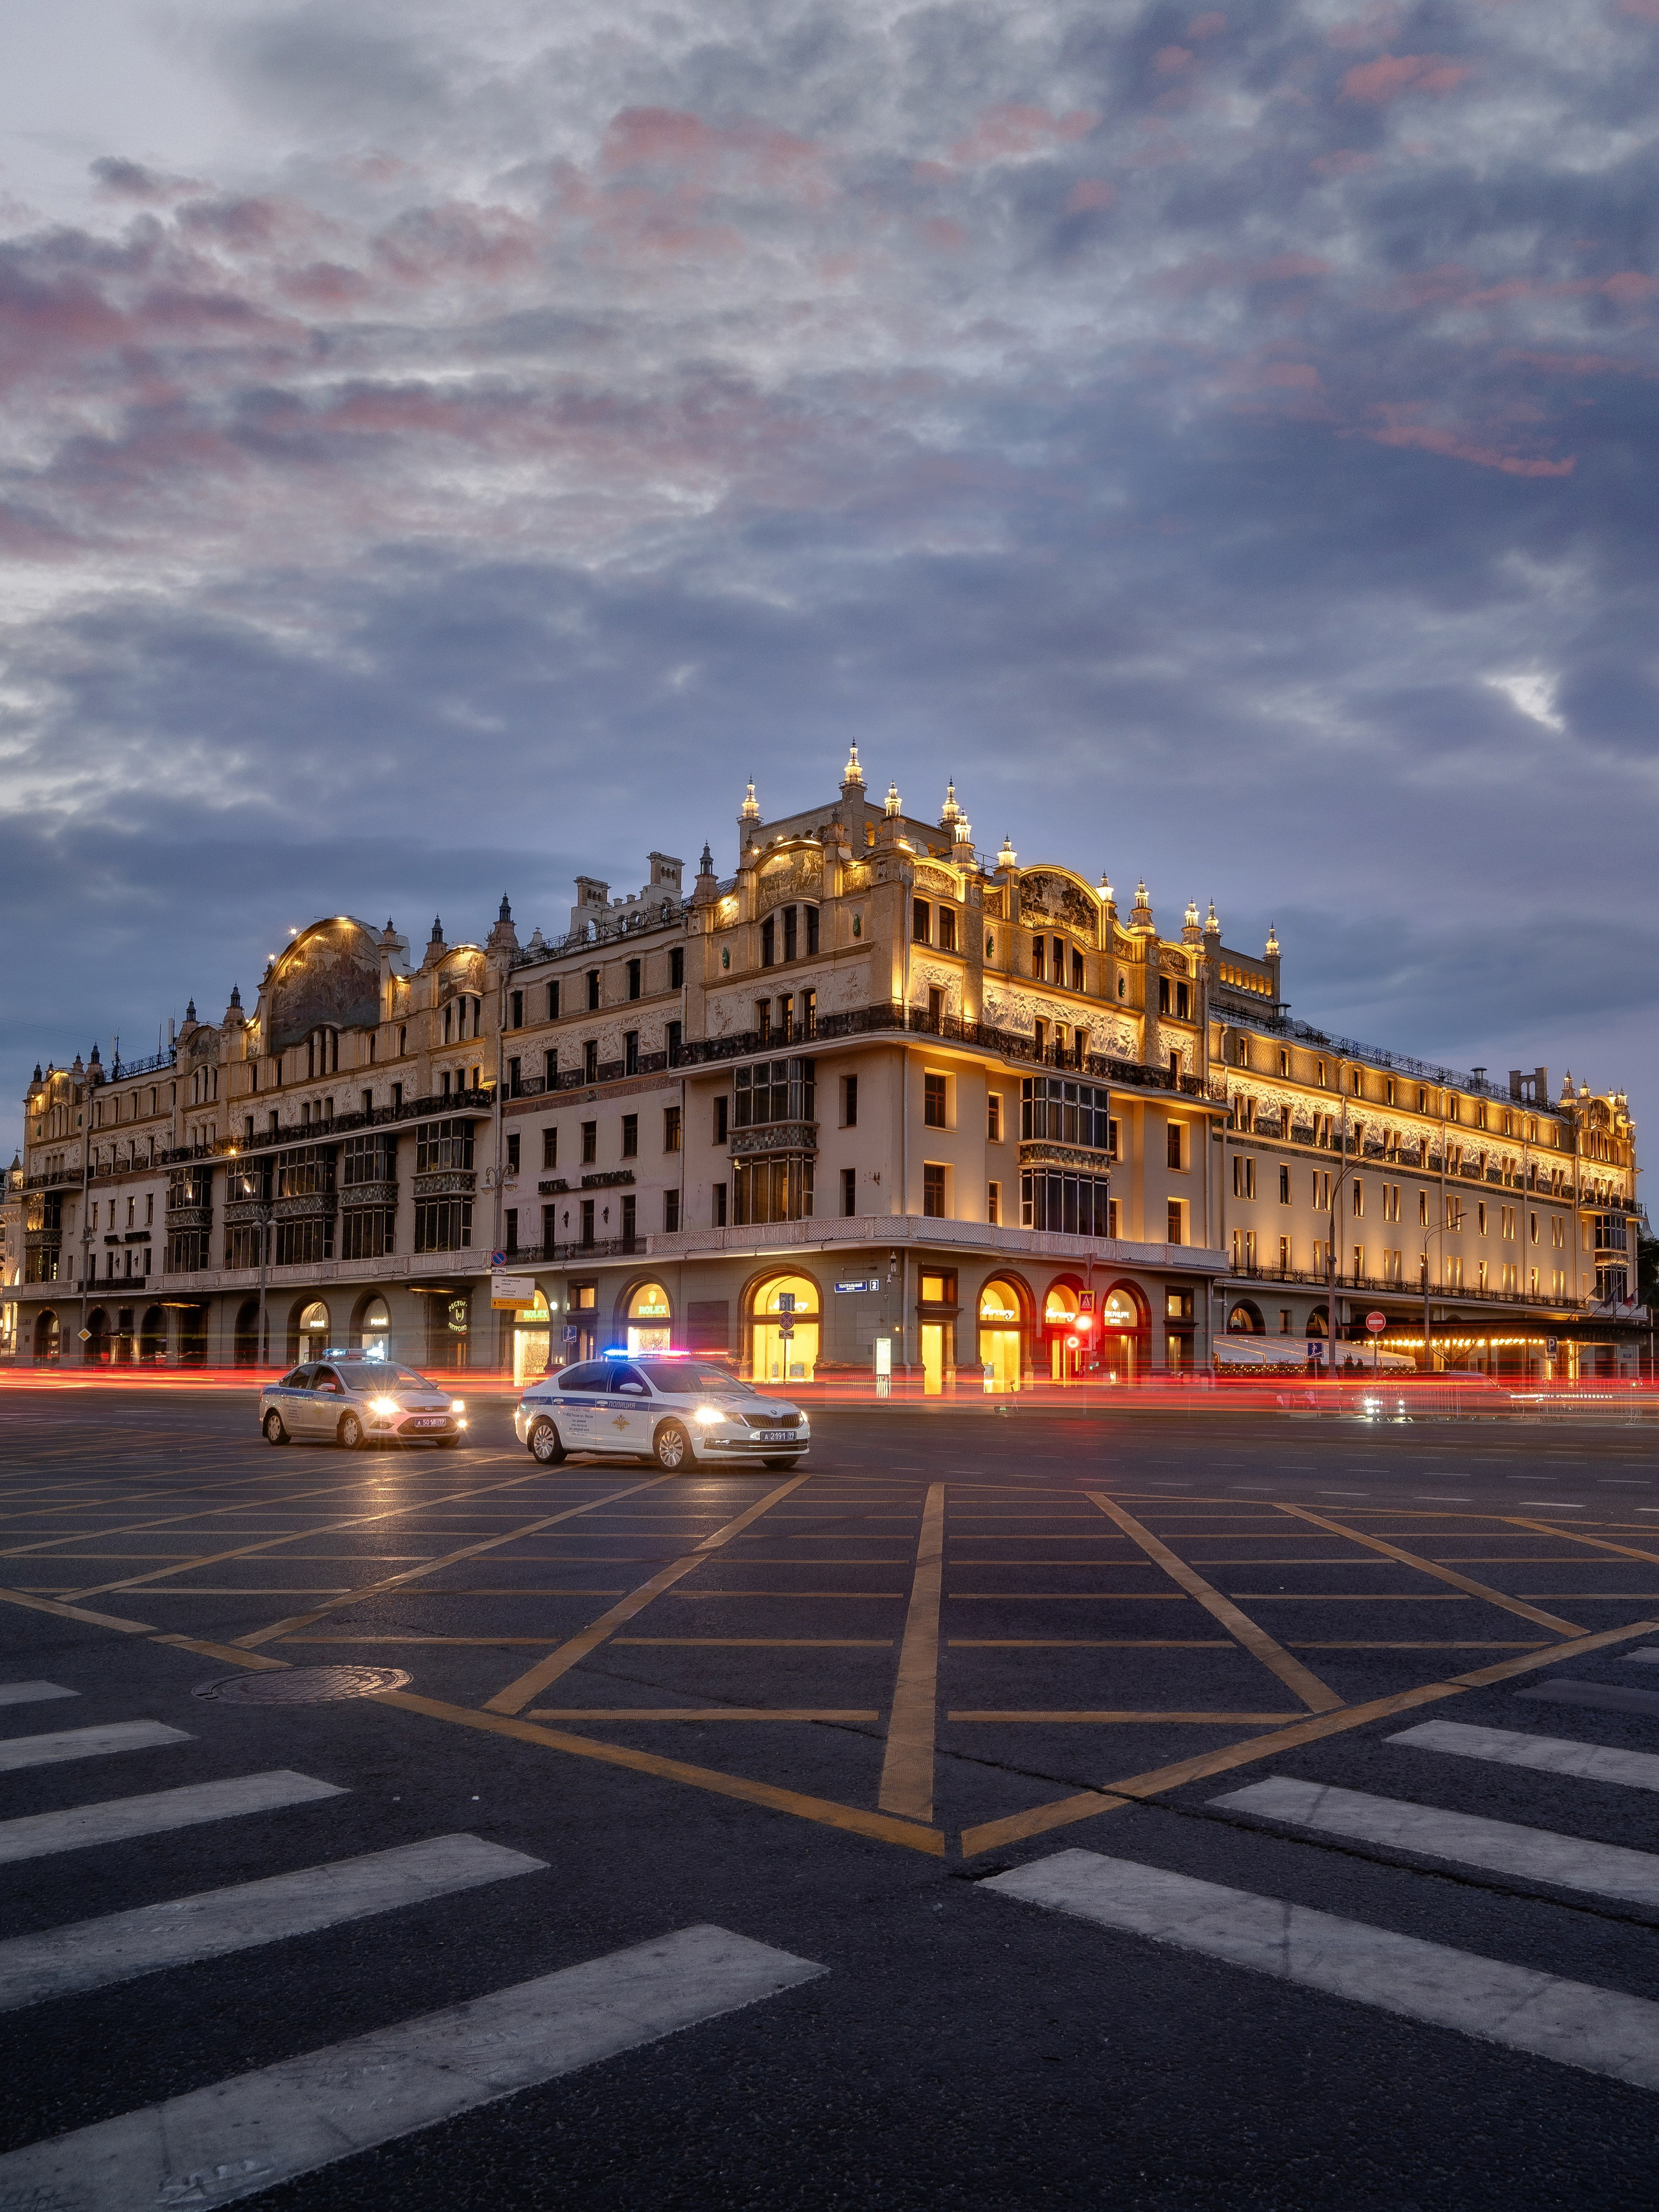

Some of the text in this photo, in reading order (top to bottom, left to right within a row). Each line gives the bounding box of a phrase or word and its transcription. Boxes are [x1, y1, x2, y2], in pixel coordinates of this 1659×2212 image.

[538, 1169, 636, 1192] HOTEL METROPOL
[523, 1310, 548, 1319] ROLEX
[638, 1305, 666, 1315] ROLEX
[980, 1304, 1016, 1320] Mercury
[1045, 1307, 1076, 1322] Mercury
[1578, 1332, 1612, 1342] METROPOL
[609, 1401, 636, 1409] ПОЛИЦИЯ
